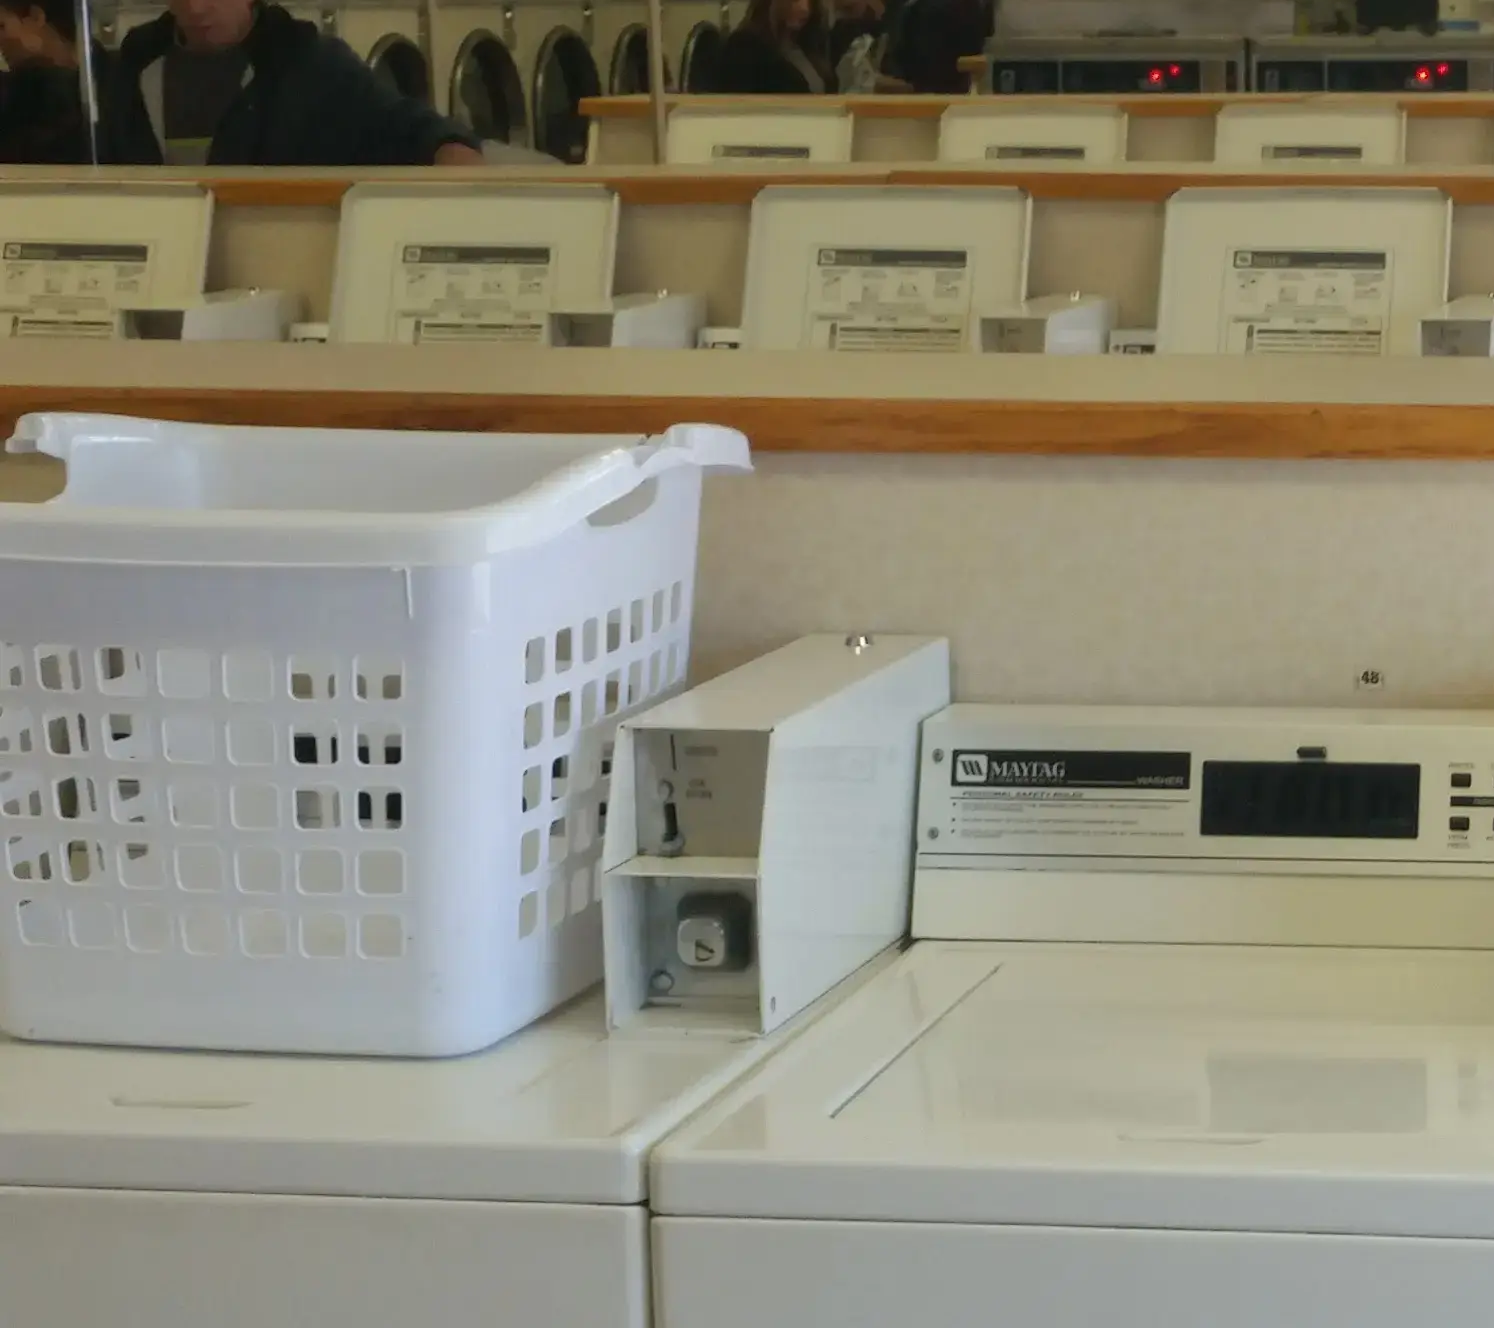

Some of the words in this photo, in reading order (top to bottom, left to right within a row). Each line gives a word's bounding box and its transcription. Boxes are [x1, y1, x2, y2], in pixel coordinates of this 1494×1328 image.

[1361, 670, 1380, 684] 48
[990, 760, 1067, 778] MAYTAG
[1136, 775, 1185, 786] WASHER
